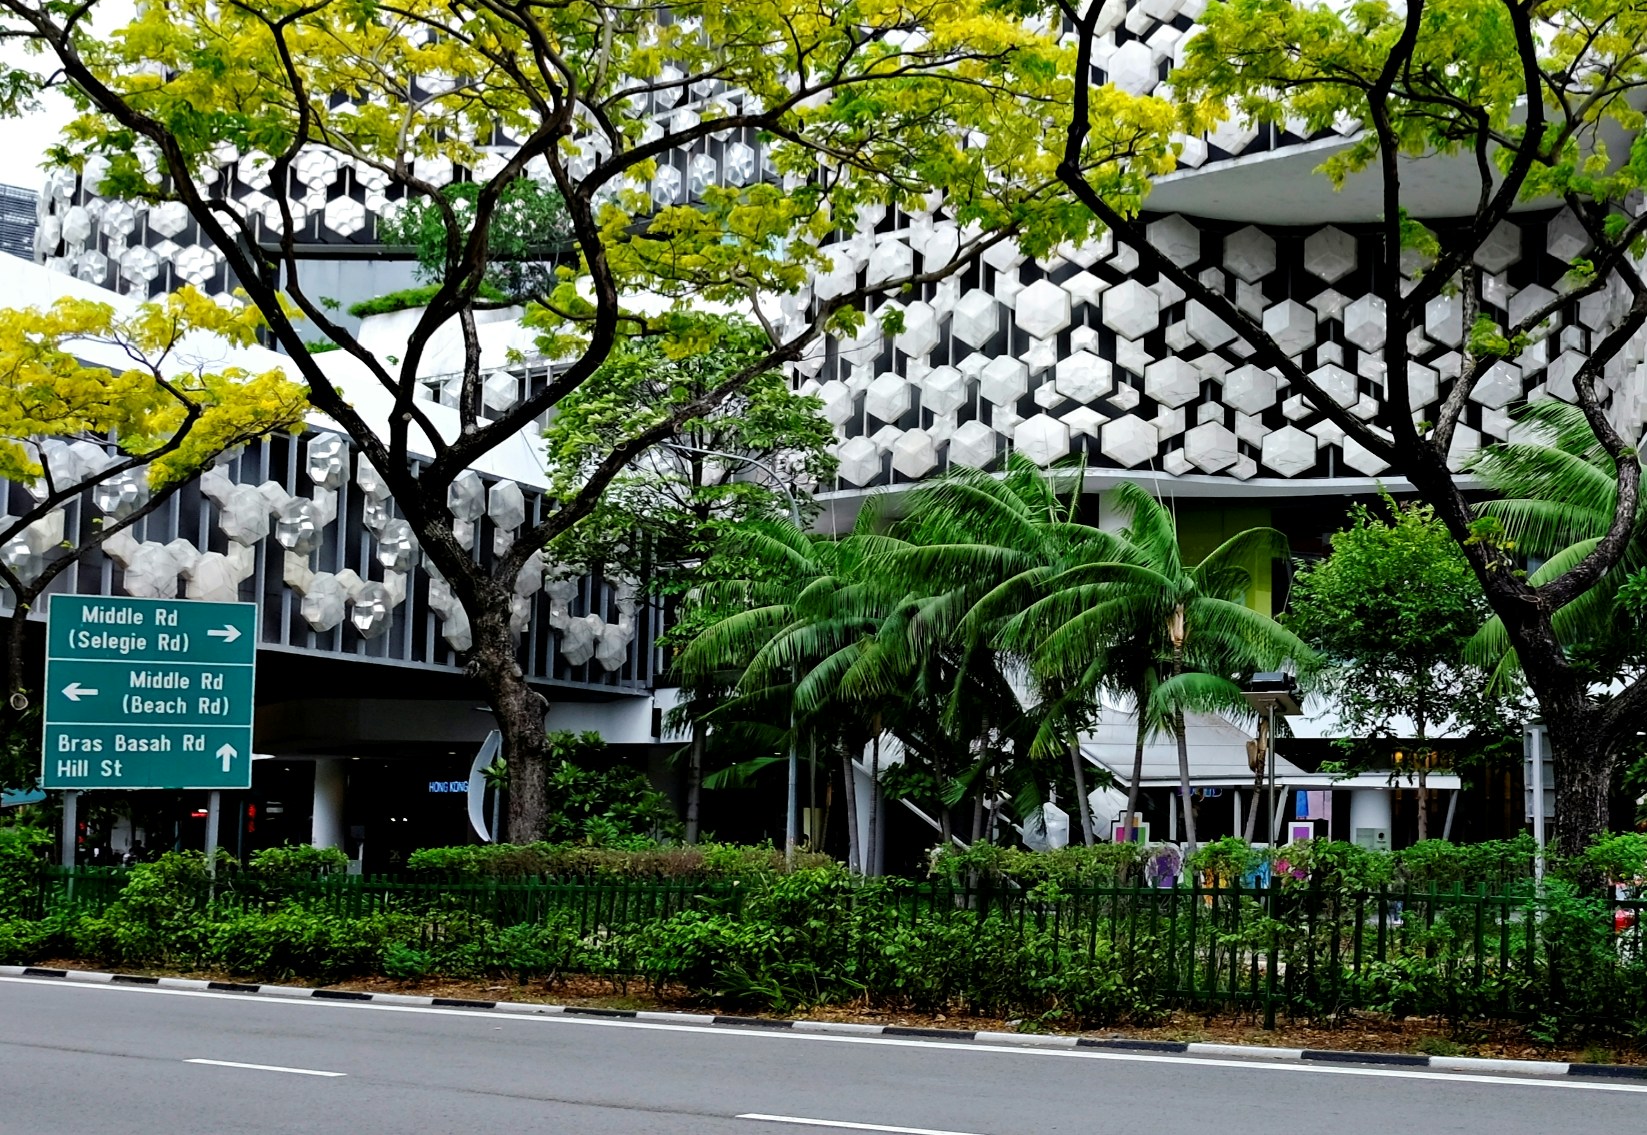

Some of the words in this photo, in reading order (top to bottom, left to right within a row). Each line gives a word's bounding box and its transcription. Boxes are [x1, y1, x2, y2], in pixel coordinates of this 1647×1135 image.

[83, 606, 143, 624] Middle
[156, 609, 177, 626] Rd
[69, 629, 146, 654] (Selegie
[159, 633, 188, 652] Rd)
[130, 671, 189, 689] Middle
[202, 673, 223, 690] Rd
[123, 694, 186, 713] (Beach
[199, 697, 228, 715] Rd)
[59, 735, 102, 751] Bras
[116, 735, 170, 751] Basah
[183, 735, 204, 751] Rd
[58, 760, 88, 777] Hill
[101, 760, 122, 776] St
[429, 782, 448, 792] HONG
